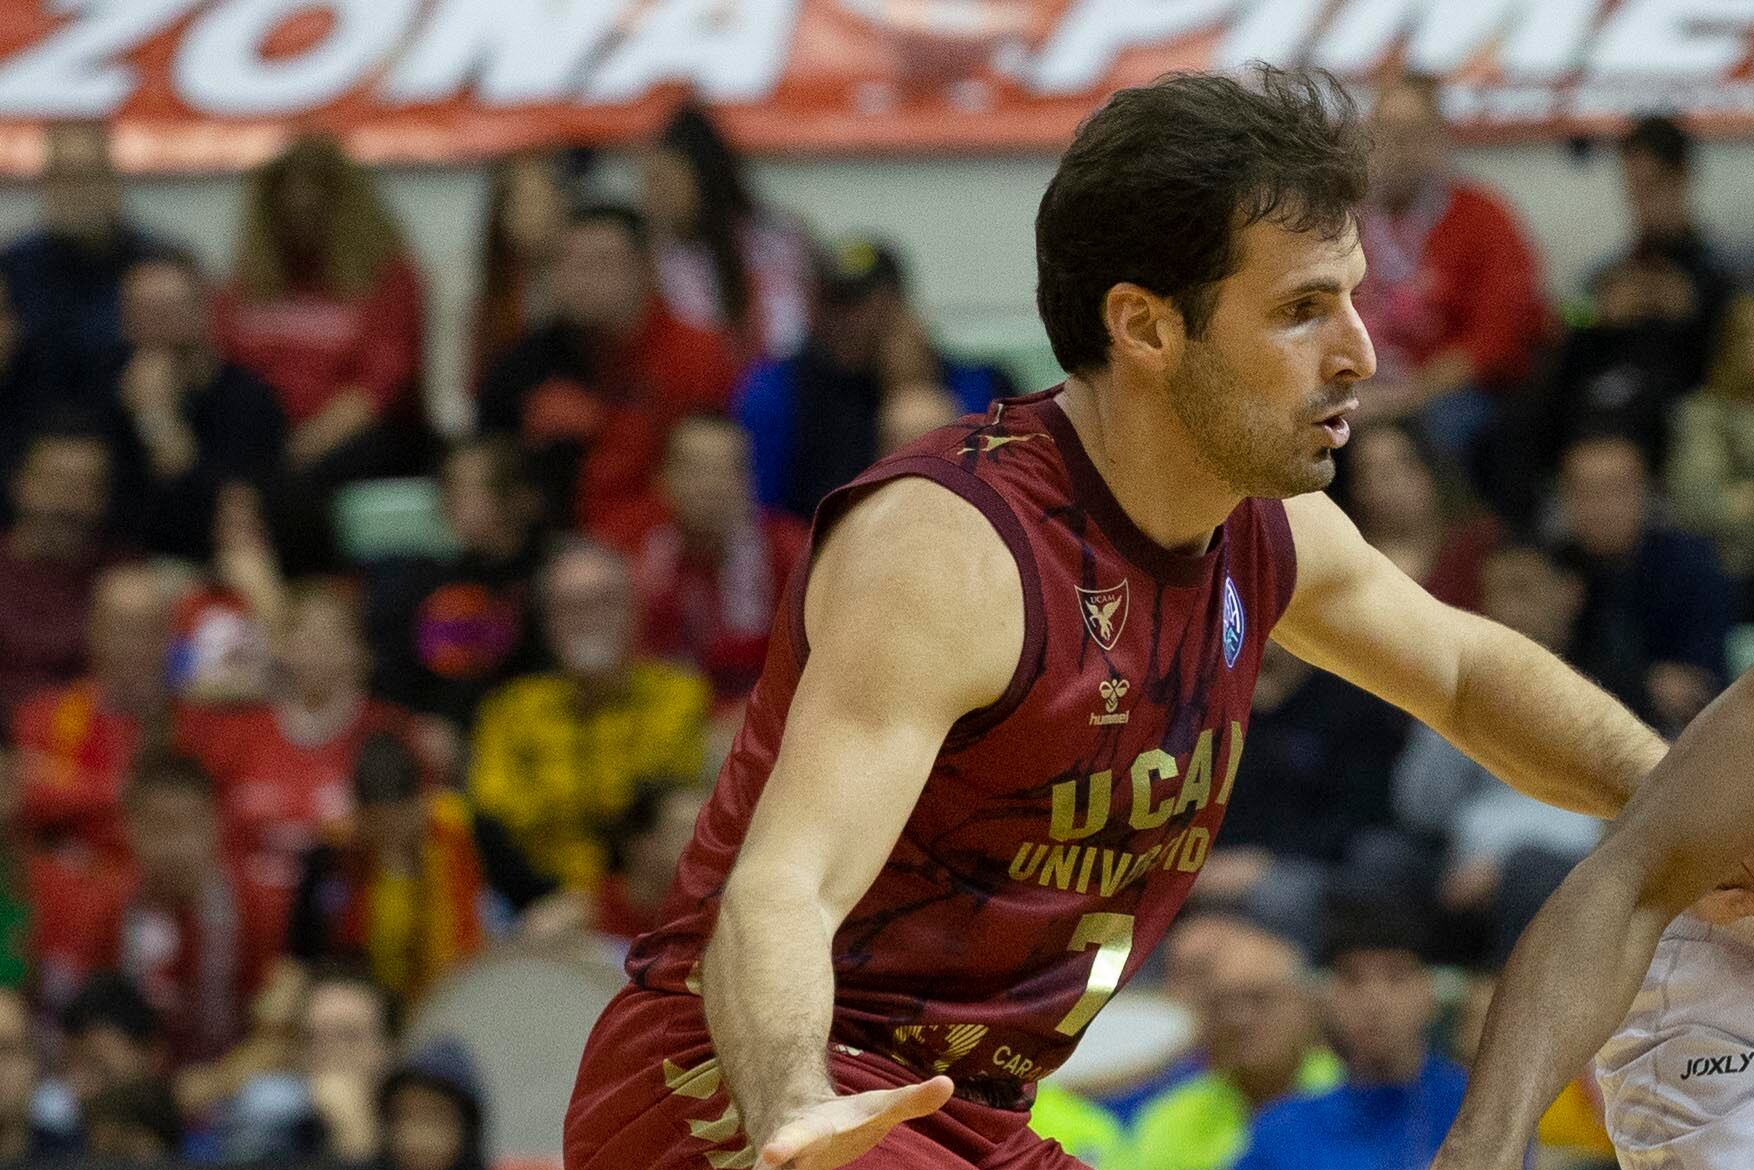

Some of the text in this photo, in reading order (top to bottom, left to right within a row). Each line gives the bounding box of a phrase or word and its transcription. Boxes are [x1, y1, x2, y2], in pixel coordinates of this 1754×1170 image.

[0, 0, 790, 116] ZONA
[1088, 710, 1130, 726] hummel
[1055, 912, 1135, 1036] 7
